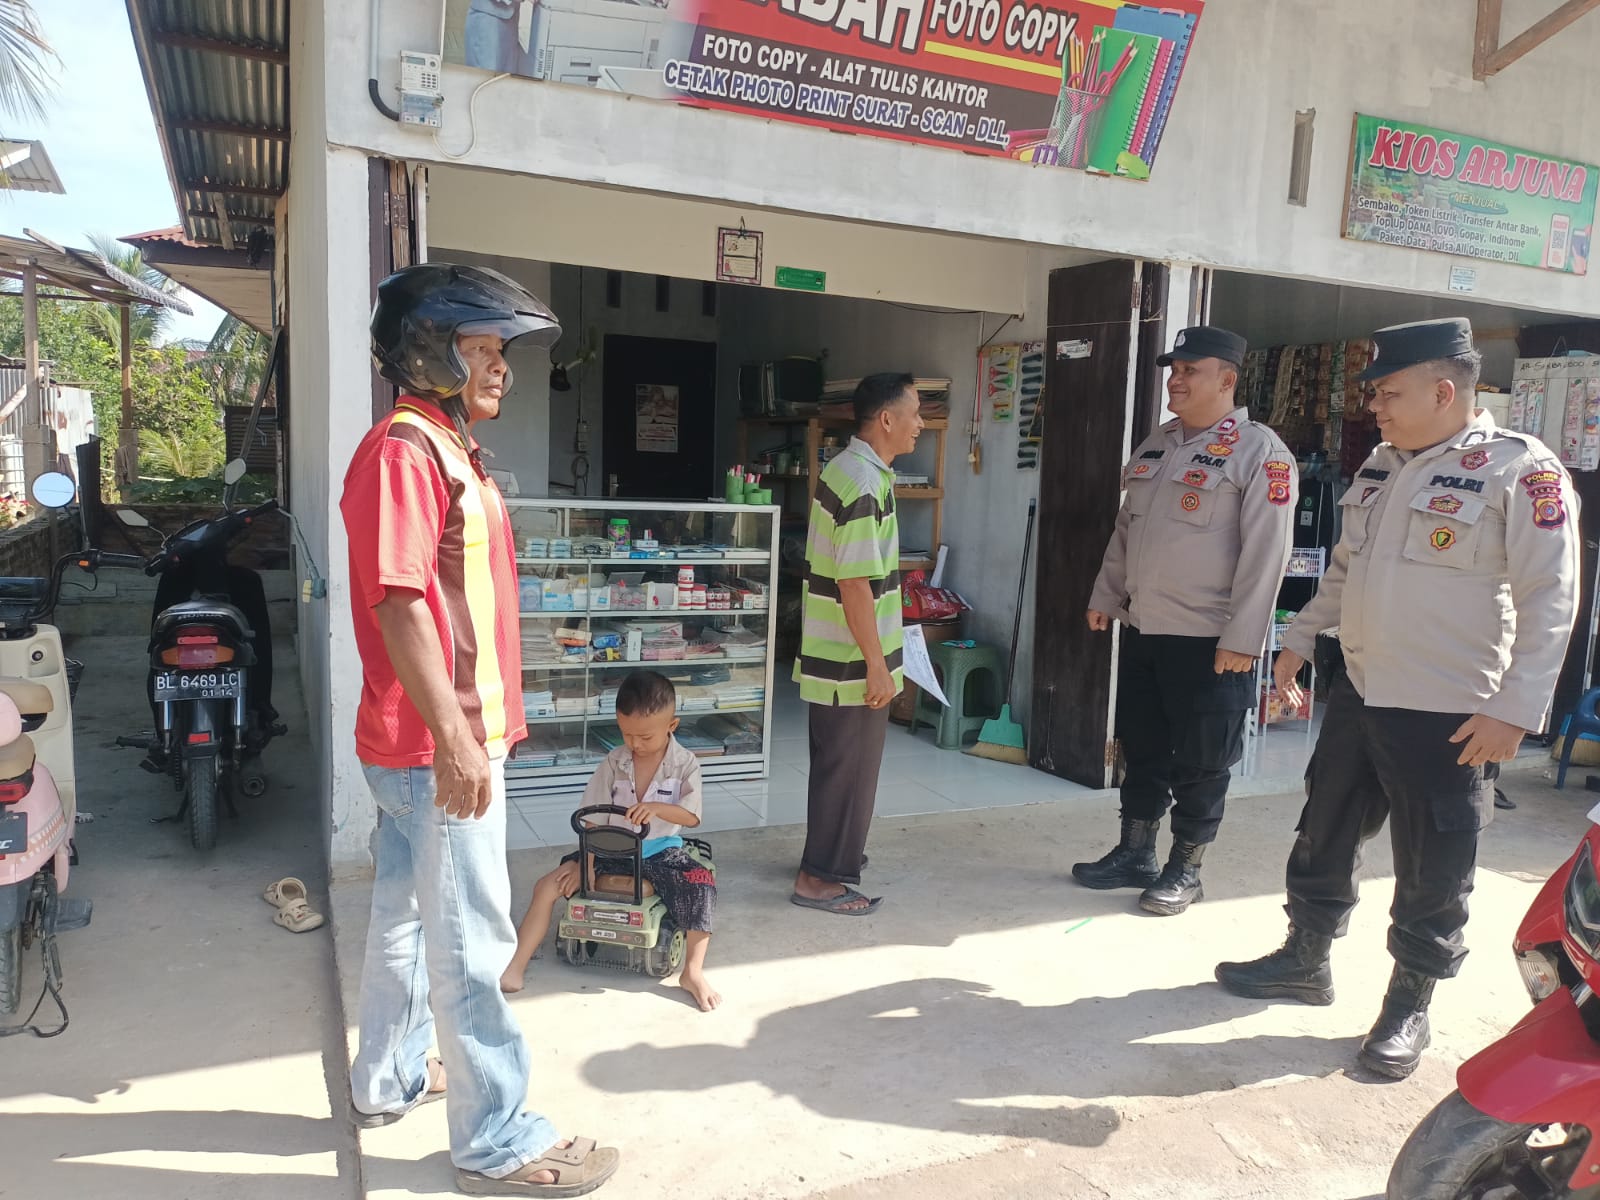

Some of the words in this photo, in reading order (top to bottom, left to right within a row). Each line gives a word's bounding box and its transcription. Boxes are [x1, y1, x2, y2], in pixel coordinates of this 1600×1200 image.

[928, 0, 1001, 42] FOTO
[1004, 4, 1078, 56] COPY
[702, 34, 752, 64] FOTO
[757, 45, 808, 74] COPY
[819, 57, 867, 85] ALAT
[870, 66, 919, 96] TULIS
[921, 77, 989, 108] KANTOR
[663, 59, 730, 97] CETAK
[731, 72, 796, 107] PHOTO
[797, 83, 853, 118] PRINT
[853, 93, 912, 128] SURAT
[920, 107, 968, 138] SCAN
[1369, 127, 1460, 178] KIOS
[1458, 146, 1587, 203] ARJUNA
[1358, 197, 1402, 214] Sembako,
[1405, 204, 1429, 218] Token
[1463, 214, 1494, 229] Transfer
[1496, 221, 1518, 232] Antar
[1520, 224, 1541, 237] Bank,
[1375, 215, 1391, 228] Top
[1393, 219, 1405, 231] Up
[1407, 221, 1434, 235] DANA,
[1460, 229, 1487, 243] Gopay,
[1489, 234, 1526, 248] Indihome
[1379, 231, 1404, 245] Paket
[1432, 240, 1454, 252] Pulsa
[1456, 243, 1467, 254] All
[1469, 245, 1506, 261] Operator,
[1191, 454, 1226, 468] POLRI
[1430, 475, 1485, 493] POLRI
[156, 676, 175, 689] BL
[181, 674, 217, 688] 6469
[221, 673, 237, 686] LC
